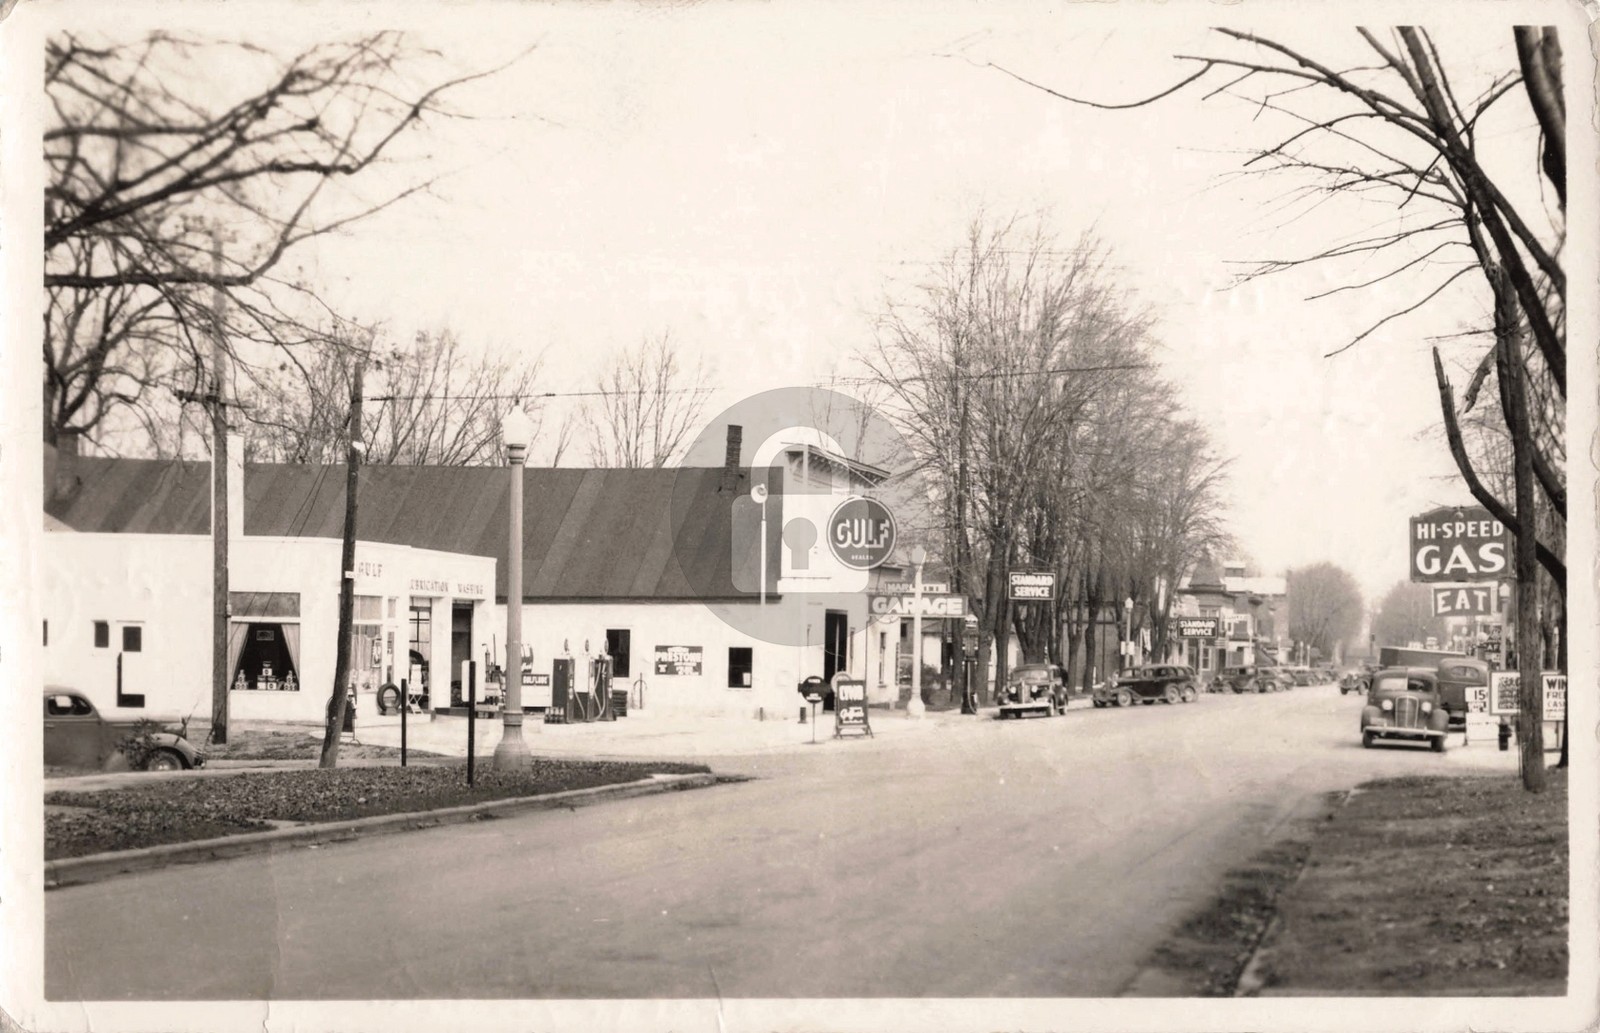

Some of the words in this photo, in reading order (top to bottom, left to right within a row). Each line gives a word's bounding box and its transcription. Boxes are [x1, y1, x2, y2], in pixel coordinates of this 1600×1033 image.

[836, 518, 891, 549] GULF
[1417, 521, 1505, 539] HI-SPEED
[1416, 542, 1506, 575] GAS
[358, 562, 383, 578] GULF
[1011, 575, 1054, 586] STANDARD
[886, 583, 947, 593] MARLTTE
[1014, 586, 1050, 597] SERVICE
[872, 597, 963, 615] GARAGE
[1437, 589, 1488, 614] EAT
[1180, 620, 1216, 628] STANDARD
[1183, 628, 1213, 636] SERVICE
[655, 652, 702, 663] PRESTONE
